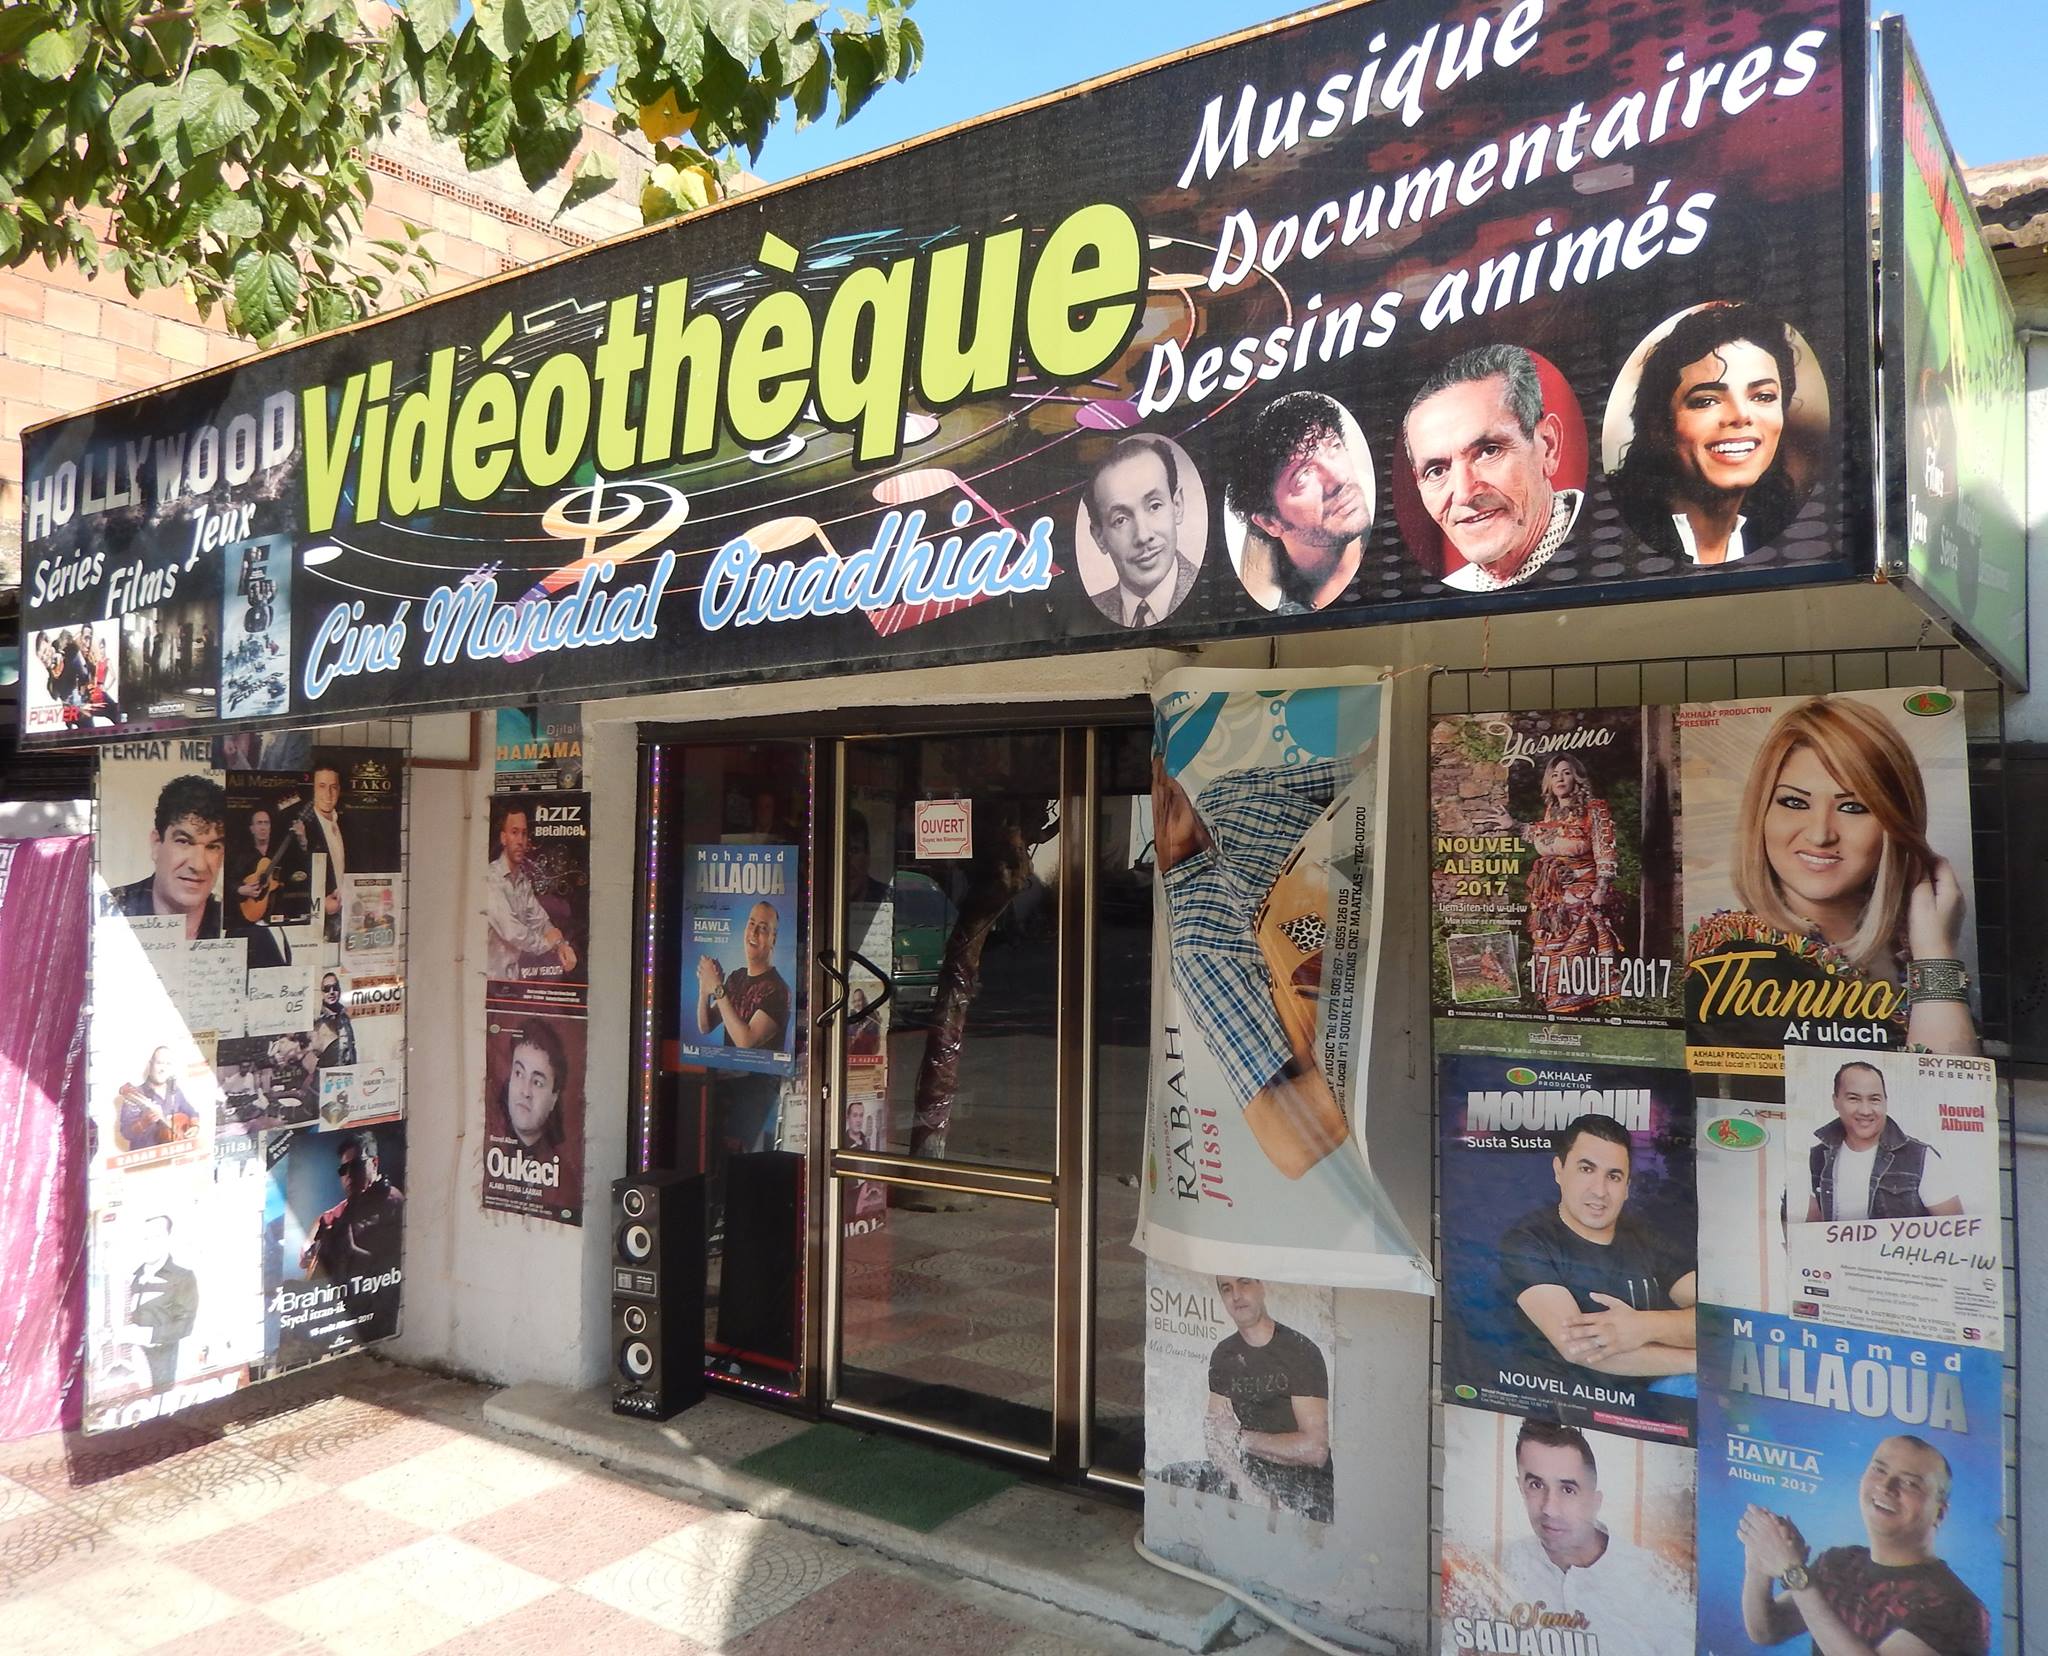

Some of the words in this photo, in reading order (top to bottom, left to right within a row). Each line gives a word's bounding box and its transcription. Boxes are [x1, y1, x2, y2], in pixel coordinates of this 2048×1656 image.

[1176, 0, 1548, 190] Musique
[1207, 30, 1831, 293] Documentaires
[1137, 288, 1404, 419] Dessins
[1420, 180, 1717, 333] animés
[303, 202, 1143, 532] Vidéothèque
[28, 389, 298, 541] HOLLYWOOD
[185, 503, 256, 572] Jeux
[31, 549, 105, 607] Séries
[700, 501, 1057, 630] Ouadhias
[105, 560, 179, 619] Films
[303, 600, 407, 699] Ciné
[424, 549, 676, 668] Mondial
[1719, 706, 1772, 717] PRODUCTION
[101, 740, 172, 761] FERHAT
[496, 740, 582, 761] HAMAMA
[1487, 722, 1616, 768] Yasmina
[352, 779, 392, 790] TAKO
[535, 805, 582, 822] AZIZ
[921, 818, 965, 834] OUVERT
[1354, 806, 1367, 865] TIZI-OUZOU
[1438, 837, 1526, 854] NOUVEL
[698, 850, 785, 862] Mohamed
[1444, 859, 1519, 875] ALBUM
[696, 862, 785, 895] ALLAOUA
[1456, 881, 1508, 896] 2017
[1351, 873, 1363, 928] MAATKAS
[694, 920, 731, 933] HAWLA
[1338, 907, 1348, 924] 126
[1333, 957, 1343, 977] 267
[1347, 952, 1357, 992] KHEMIS
[1527, 955, 1550, 994] 17
[1557, 947, 1614, 997] AOÛT
[1620, 957, 1672, 998] 2017
[351, 987, 402, 1005] MILOUD
[1331, 978, 1341, 997] 503
[1689, 950, 1906, 1024] Thanina
[286, 1000, 303, 1013] 05
[1344, 995, 1353, 1009] EL
[1340, 1010, 1351, 1039] SOUK
[1784, 1021, 1809, 1041] Af
[1817, 1021, 1888, 1044] ulach
[1693, 1050, 1725, 1058] AKHALAF
[1726, 1052, 1773, 1060] PRODUCTION
[1759, 1062, 1778, 1070] SOUK
[1918, 1057, 1944, 1068] SKY
[1946, 1058, 1991, 1072] PROD'S
[1337, 1059, 1347, 1088] Local
[1538, 1070, 1593, 1083] AKHALAF
[1538, 1080, 1592, 1090] PRODUCTION
[1918, 1069, 1992, 1082] PRESENTE
[1164, 1023, 1200, 1203] RABAH
[1466, 1089, 1652, 1132] MOUMOUH
[1739, 1108, 1786, 1121] AKH
[1938, 1103, 1985, 1119] Nouvel
[1940, 1117, 1985, 1133] Album
[1467, 1136, 1507, 1149] Susta
[1511, 1136, 1552, 1149] Susta
[487, 1147, 560, 1188] Oukaci
[1194, 1107, 1234, 1208] flissi
[1826, 1224, 1878, 1244] SAID
[1890, 1218, 1982, 1242] YOUCEF
[281, 1283, 348, 1314] Brahim
[350, 1266, 402, 1295] Tayeb
[1149, 1286, 1225, 1325] SMAIL
[1154, 1316, 1218, 1341] BELOUNIS
[1732, 1318, 1961, 1372] Mohamed
[1499, 1370, 1569, 1396] NOUVEL
[1572, 1384, 1636, 1408] ALBUM
[1728, 1339, 1969, 1434] ALLAOUA
[1728, 1438, 1820, 1475] HAWLA
[1728, 1466, 1776, 1485] Album
[1780, 1475, 1818, 1495] 2017
